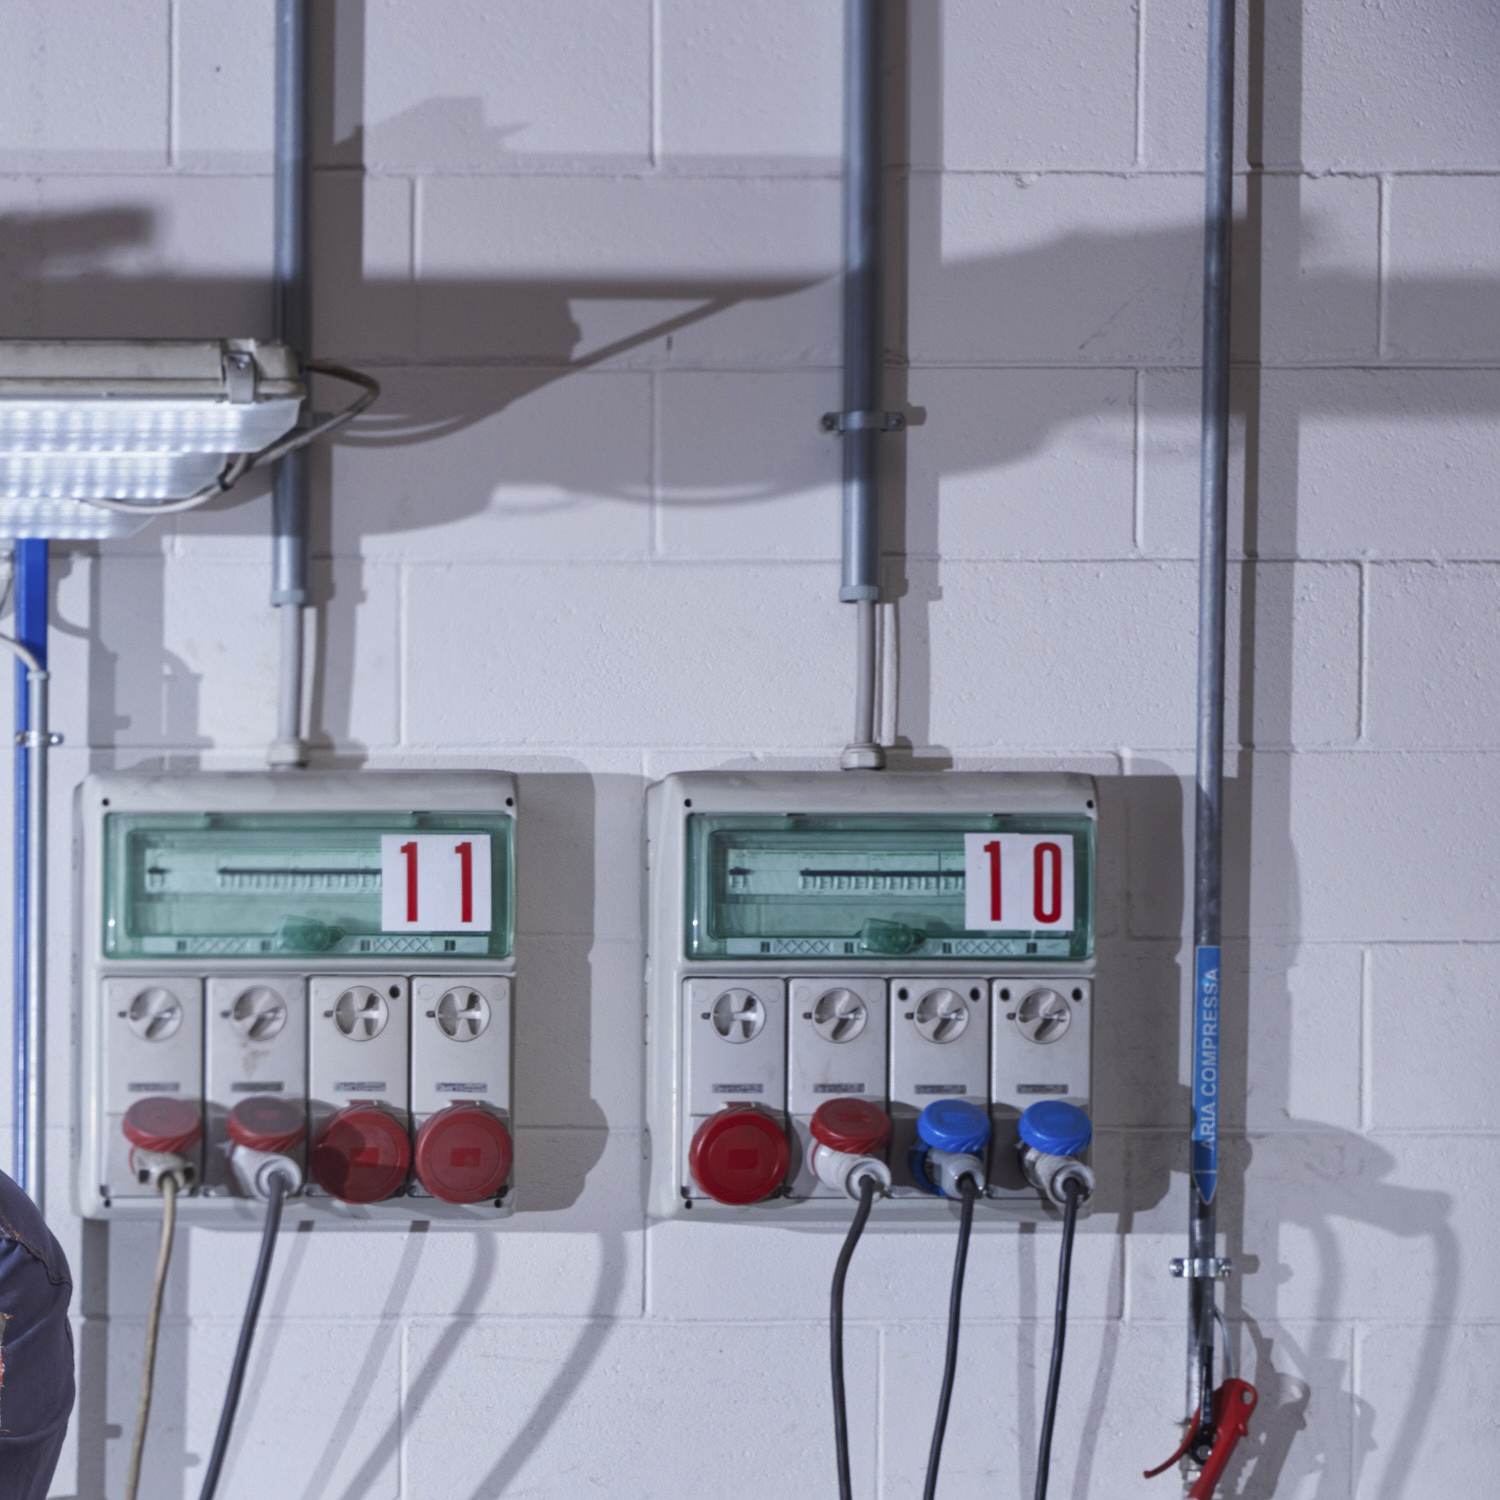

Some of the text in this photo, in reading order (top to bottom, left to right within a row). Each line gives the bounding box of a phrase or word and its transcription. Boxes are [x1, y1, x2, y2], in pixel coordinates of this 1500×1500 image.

[400, 841, 473, 923] 11
[983, 840, 1062, 924] 10
[1201, 967, 1219, 1151] ARIA COMPRESSA
